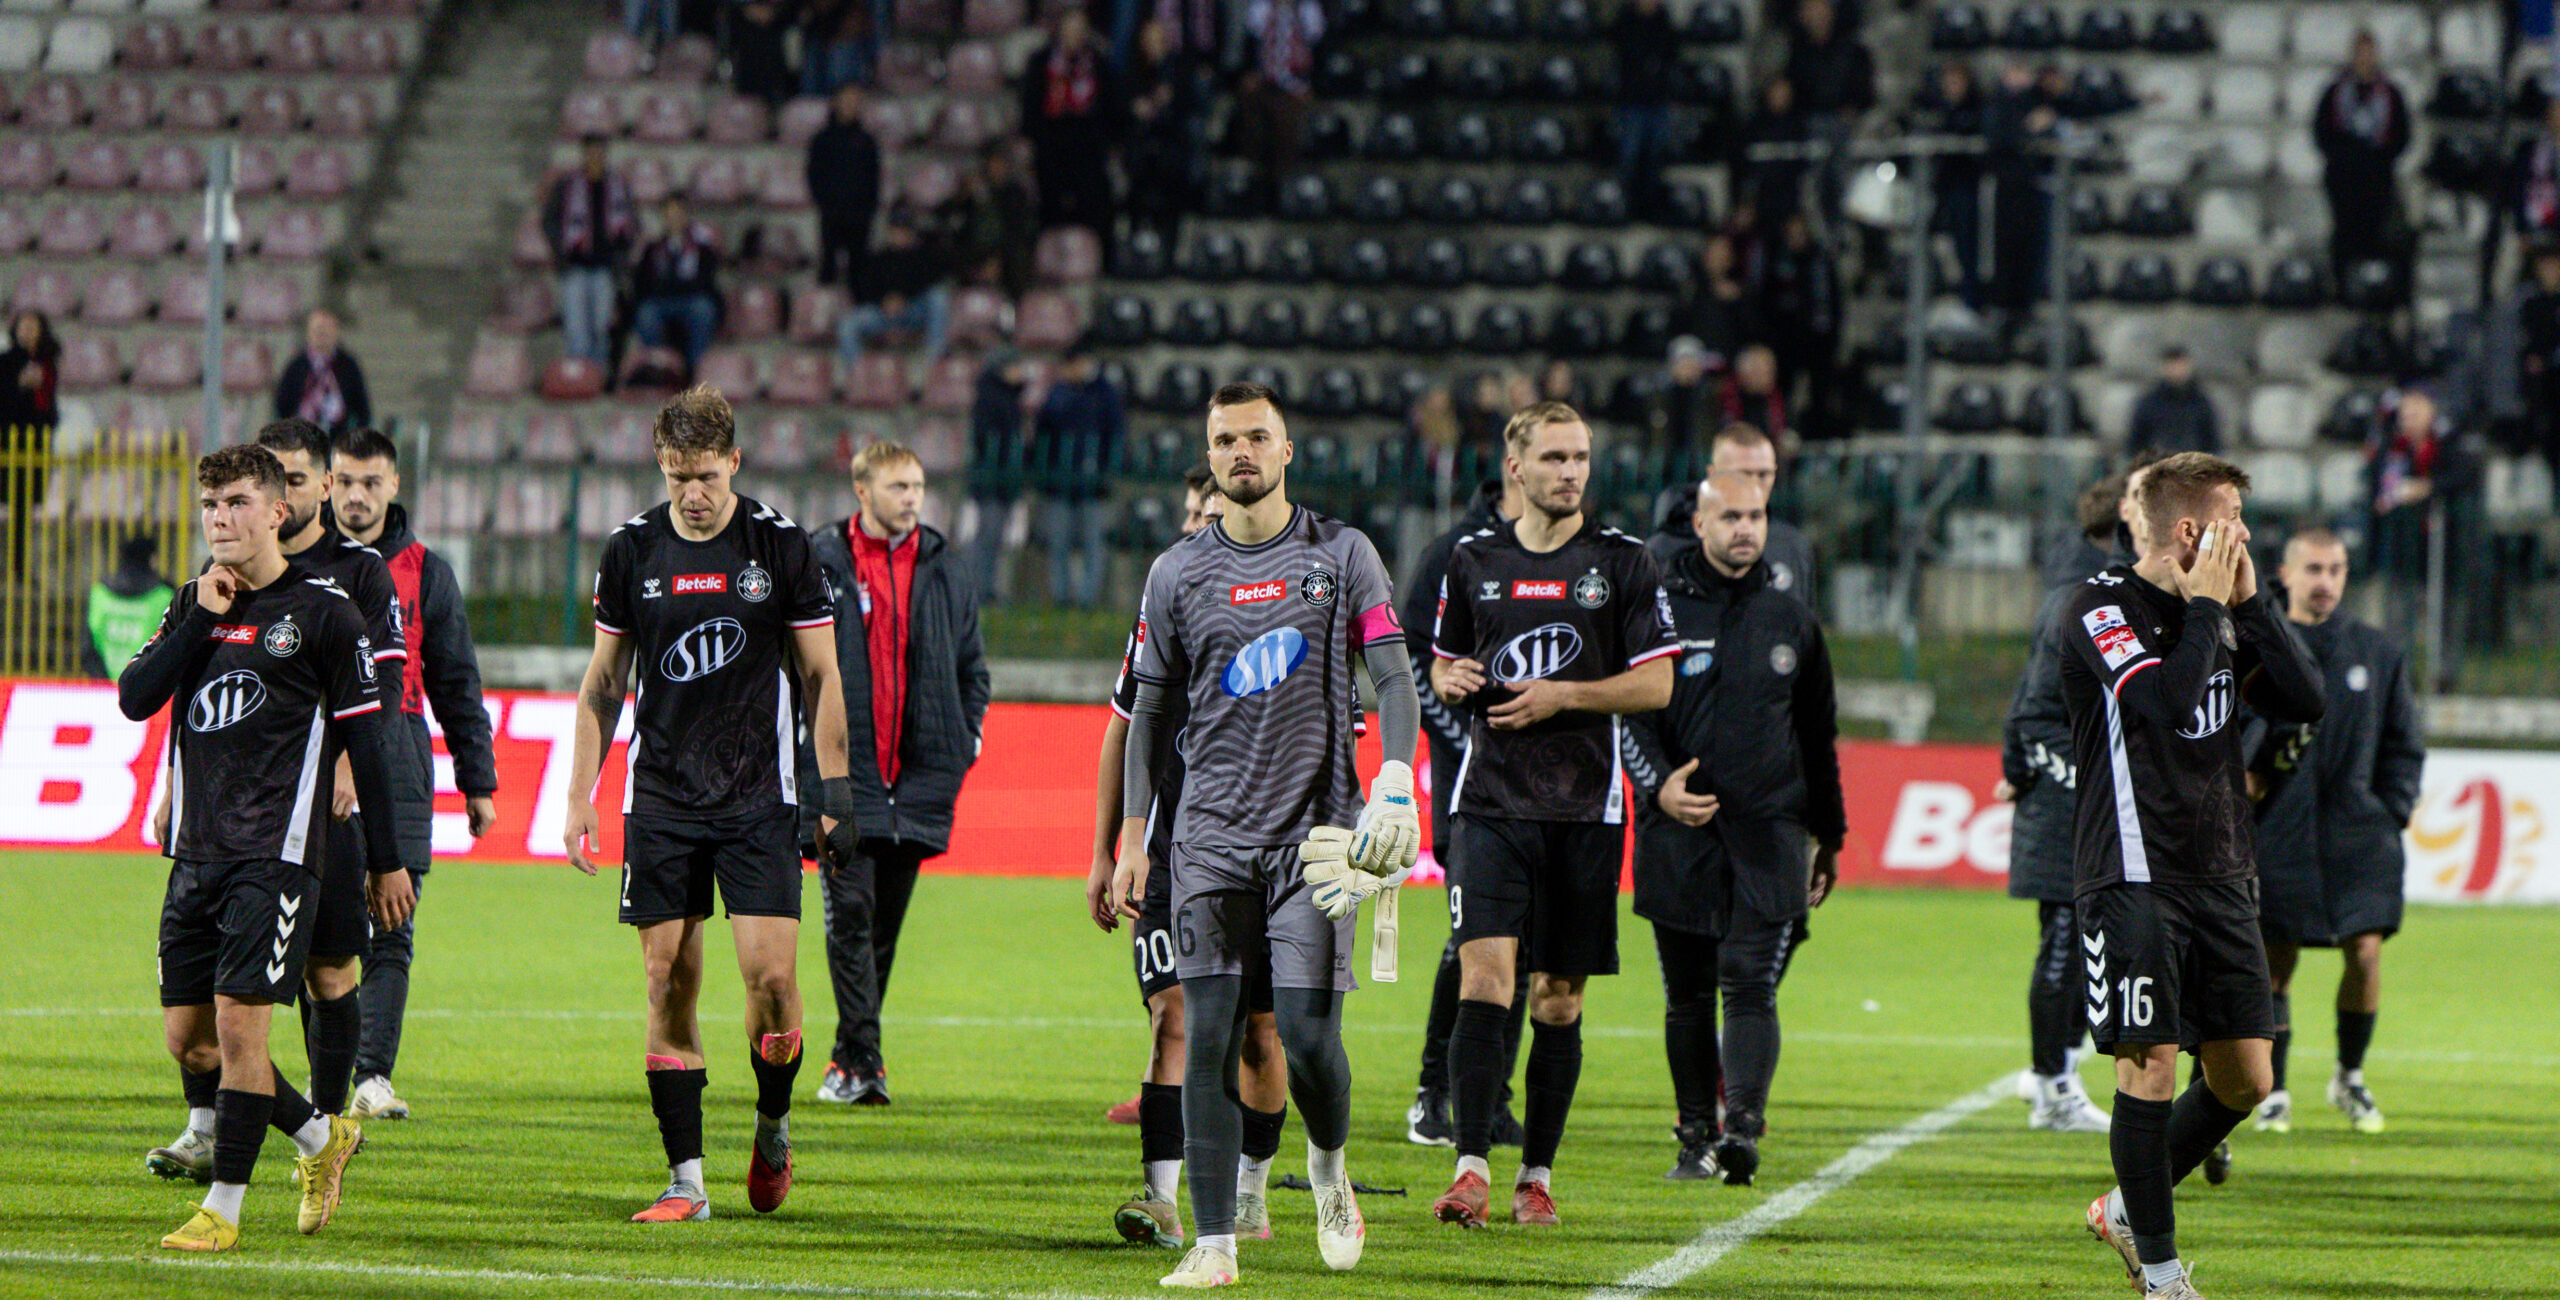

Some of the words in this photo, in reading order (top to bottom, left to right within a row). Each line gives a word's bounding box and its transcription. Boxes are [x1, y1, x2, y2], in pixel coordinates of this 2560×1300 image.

[676, 576, 722, 591] Betclic
[1235, 583, 1281, 602] Betclic
[1515, 583, 1562, 597] Betclic
[211, 626, 252, 641] Betclic
[1450, 885, 1463, 929] 9
[1135, 929, 1175, 982] 20
[2117, 976, 2154, 1027] 16
